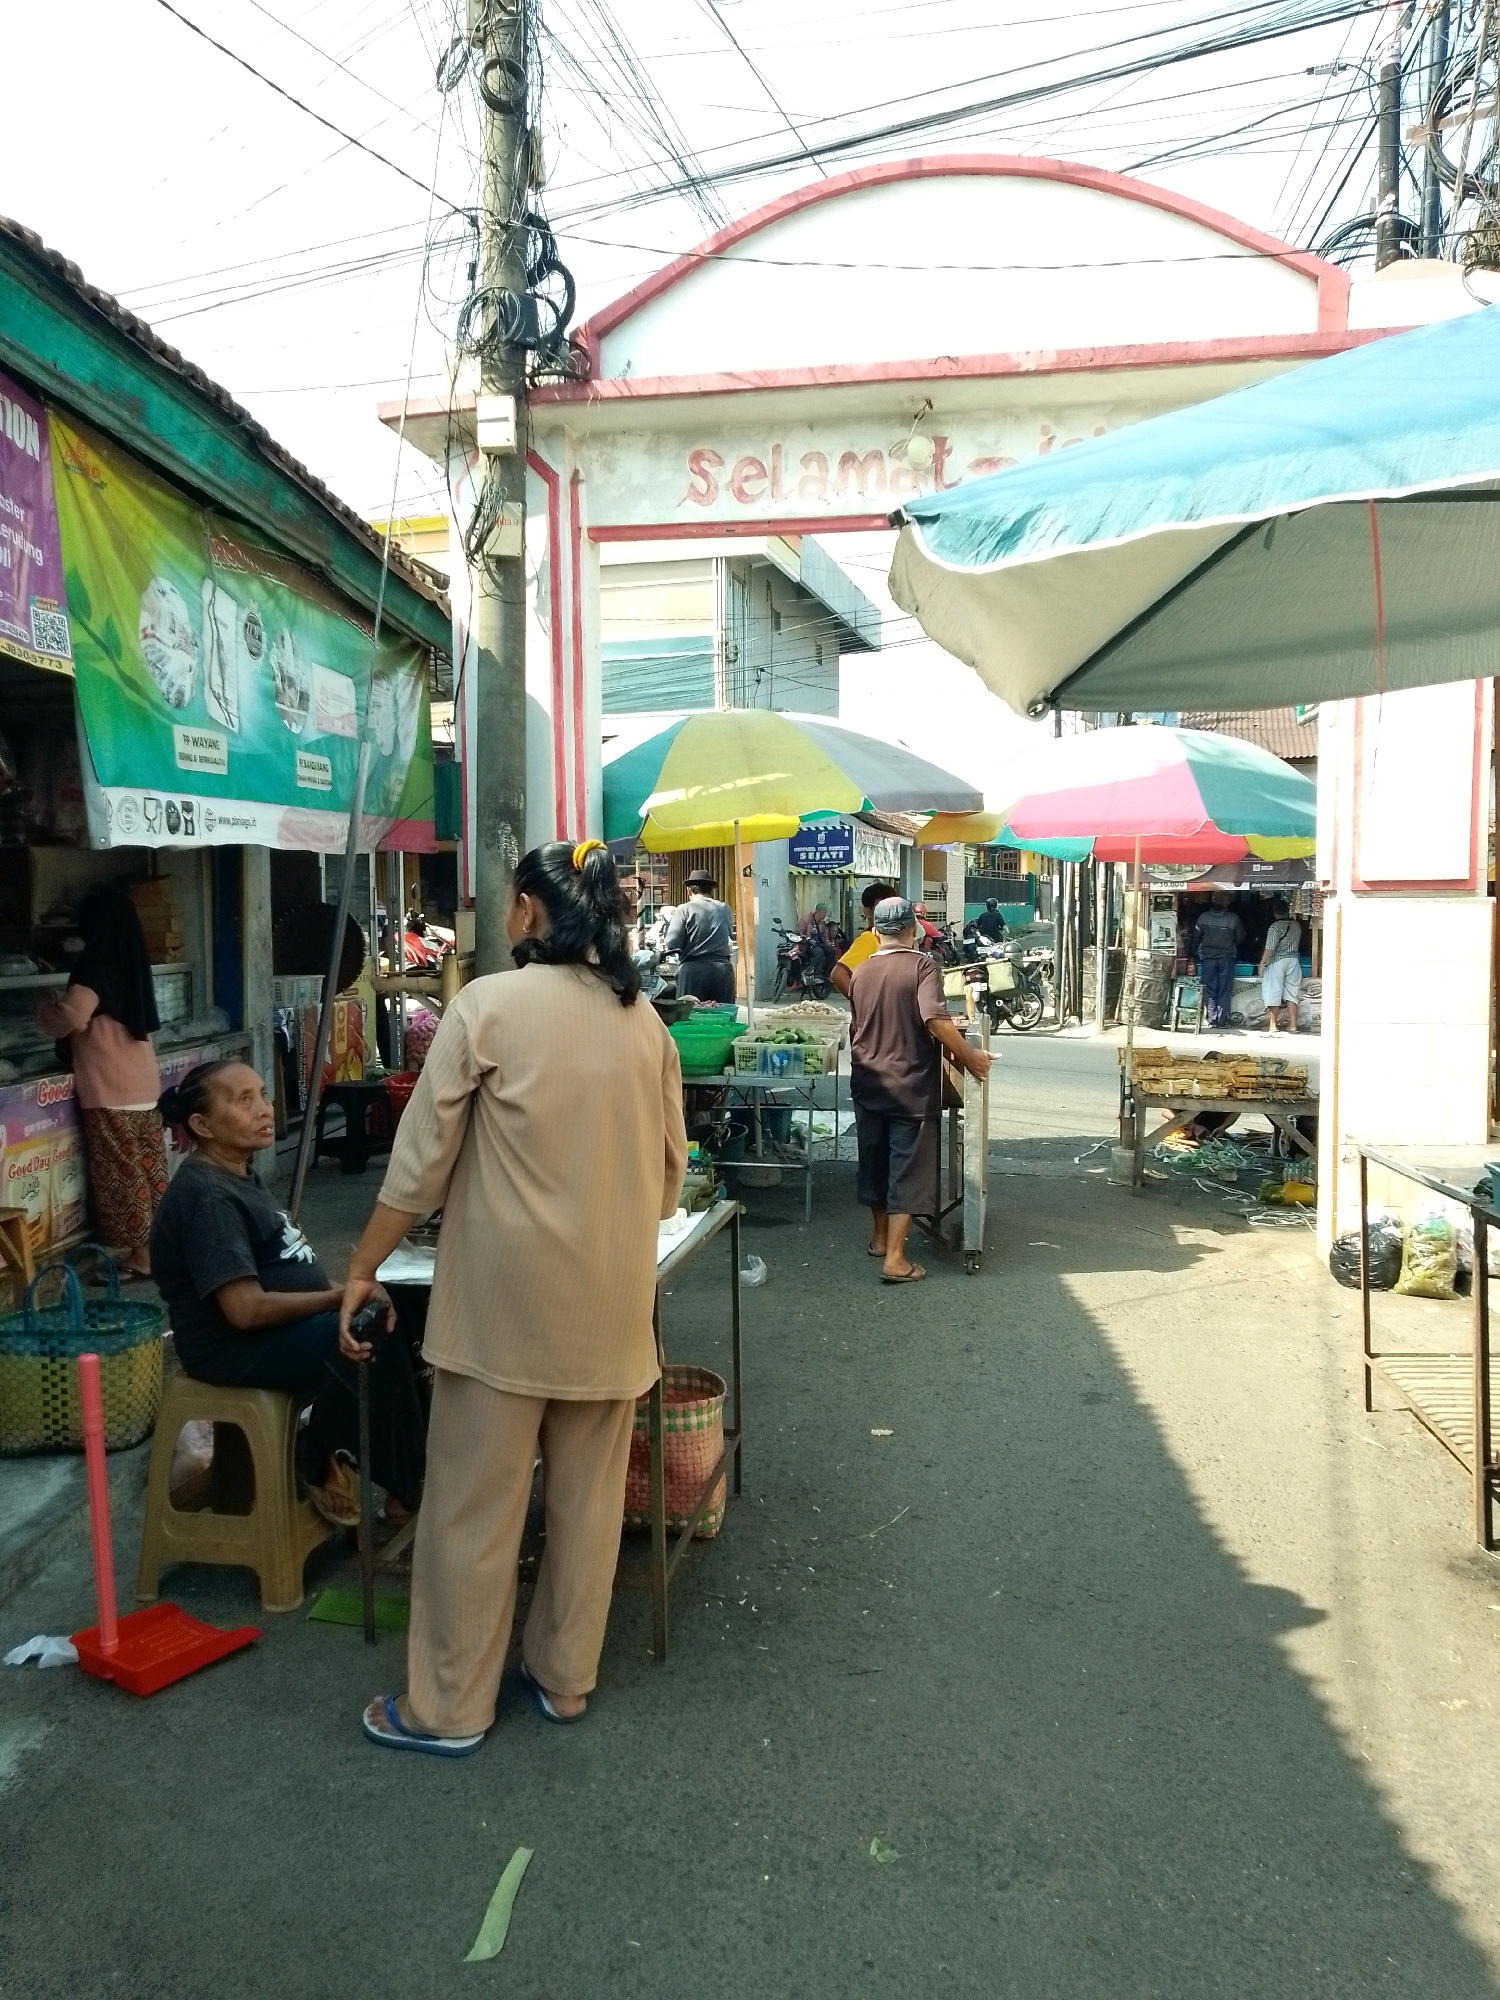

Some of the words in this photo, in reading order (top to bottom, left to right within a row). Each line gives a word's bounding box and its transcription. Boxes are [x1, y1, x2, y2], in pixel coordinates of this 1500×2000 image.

[0, 392, 39, 462] ION
[800, 851, 844, 860] SEJATI
[8, 1157, 33, 1180] Good
[33, 1154, 51, 1173] Day
